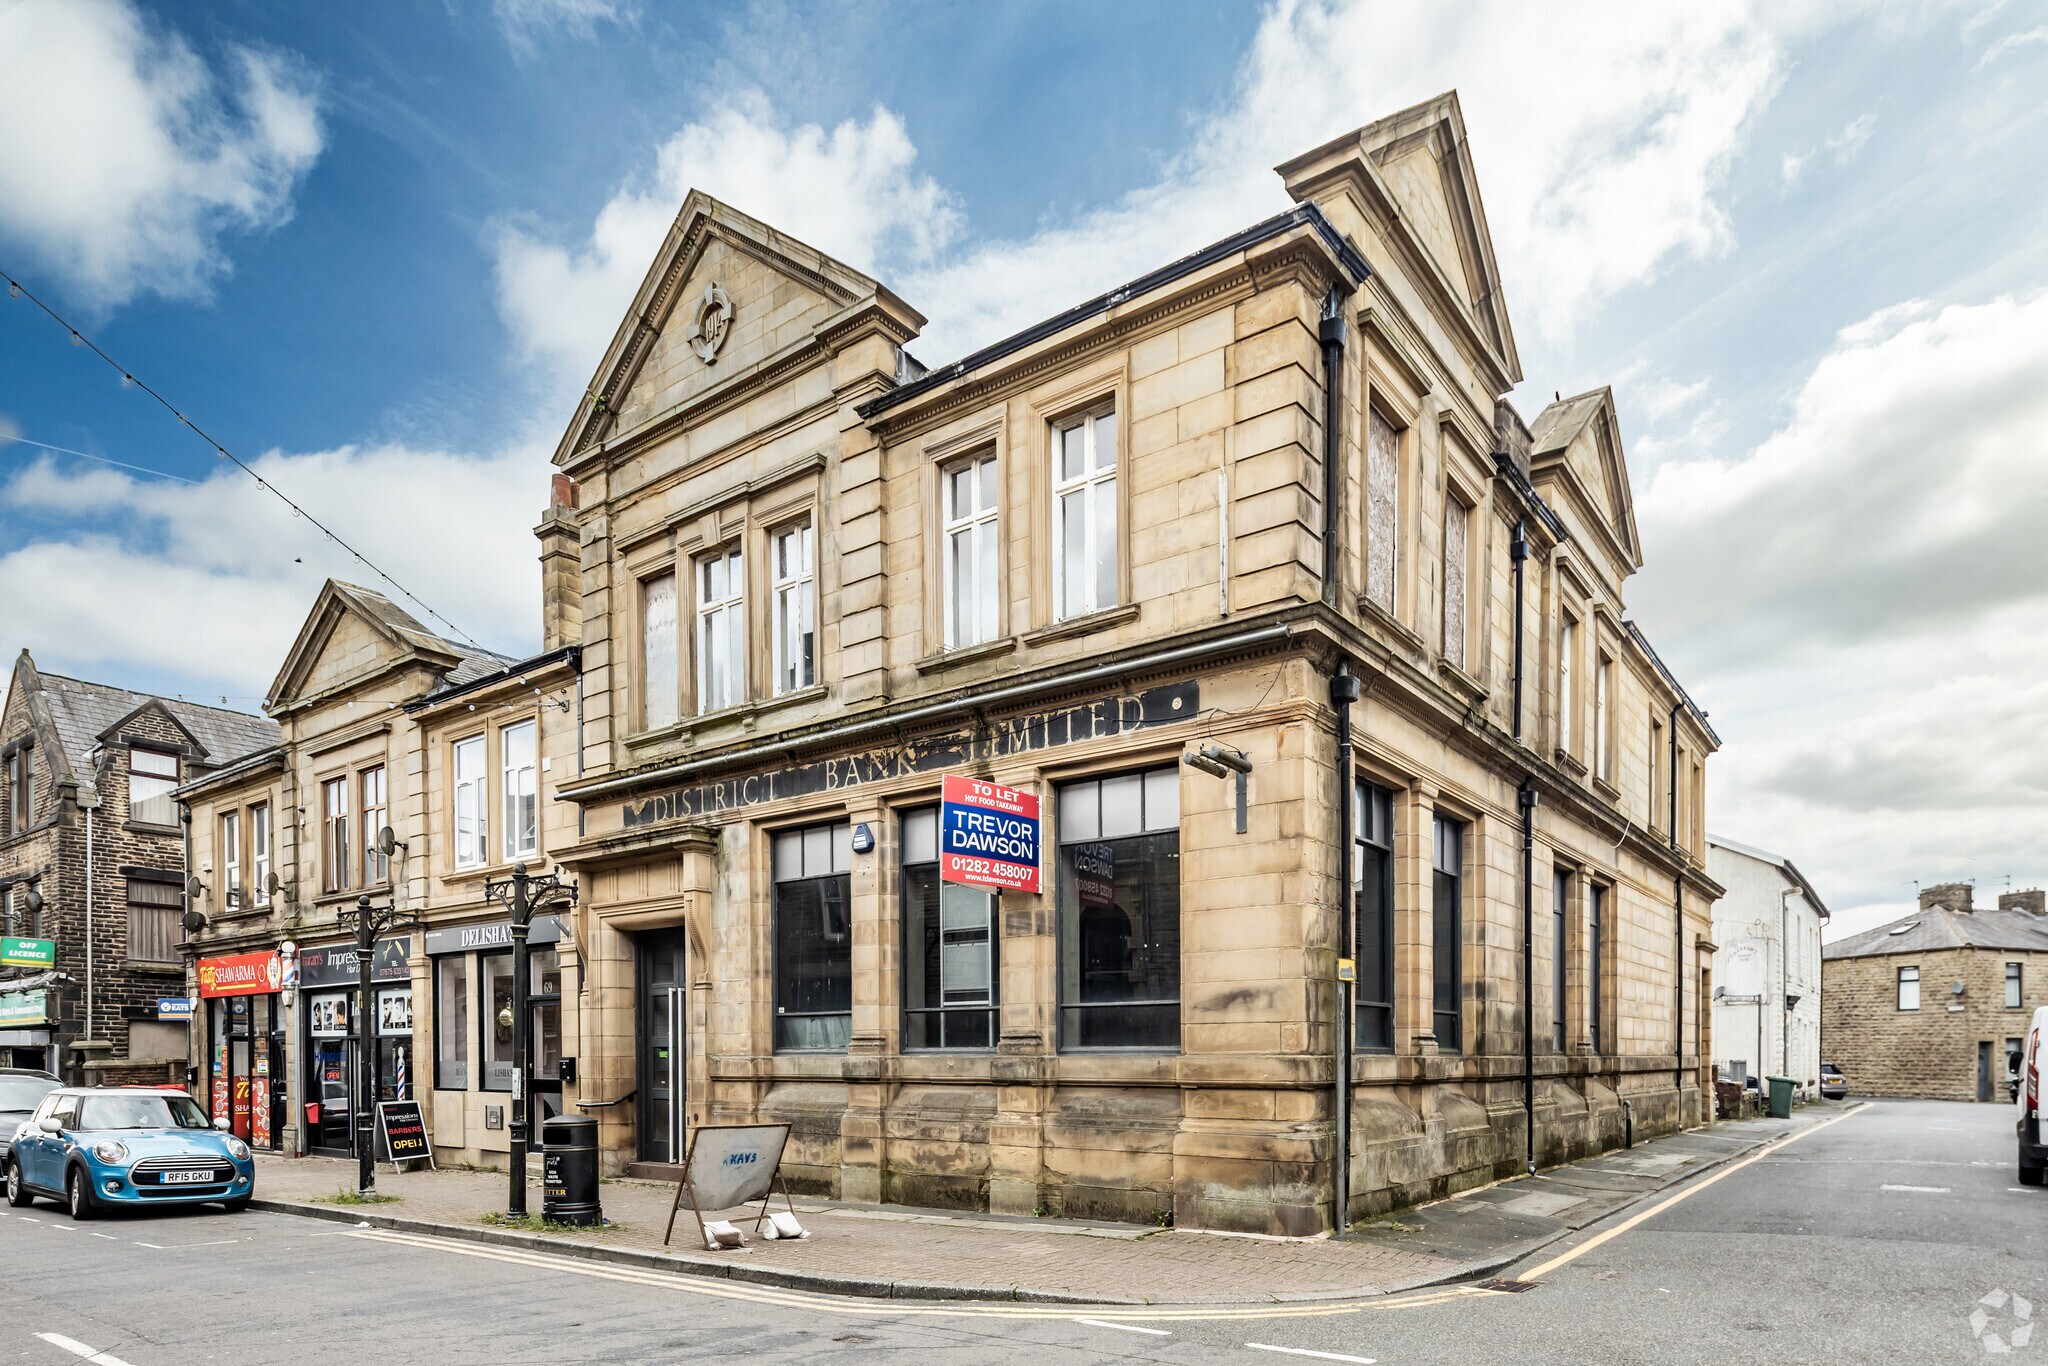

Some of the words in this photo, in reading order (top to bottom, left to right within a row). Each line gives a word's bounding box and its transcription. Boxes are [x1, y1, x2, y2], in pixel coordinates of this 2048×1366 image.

[651, 772, 780, 823] DISTRICT
[826, 744, 917, 790] BANK
[972, 783, 992, 796] TO
[996, 788, 1019, 803] LET
[964, 794, 978, 803] HOT
[978, 797, 995, 807] FOOD
[996, 800, 1024, 813] TAKEAWAY
[953, 810, 1032, 841] TREVOR
[953, 829, 1033, 860] DAWSON
[951, 856, 990, 874] 01282
[993, 862, 1033, 881] 458007
[965, 873, 1022, 888] www.tdawson.co.uk
[18, 941, 38, 950] OFF
[8, 949, 47, 959] LICENCE
[200, 965, 216, 991] Tasty
[215, 964, 256, 984] SHAWARMA
[543, 981, 553, 994] 69
[326, 1071, 341, 1080] OPEN
[386, 1112, 419, 1122] Impressions
[388, 1125, 423, 1135] BARBERS
[168, 1172, 190, 1182] RF15
[191, 1171, 211, 1181] GKU
